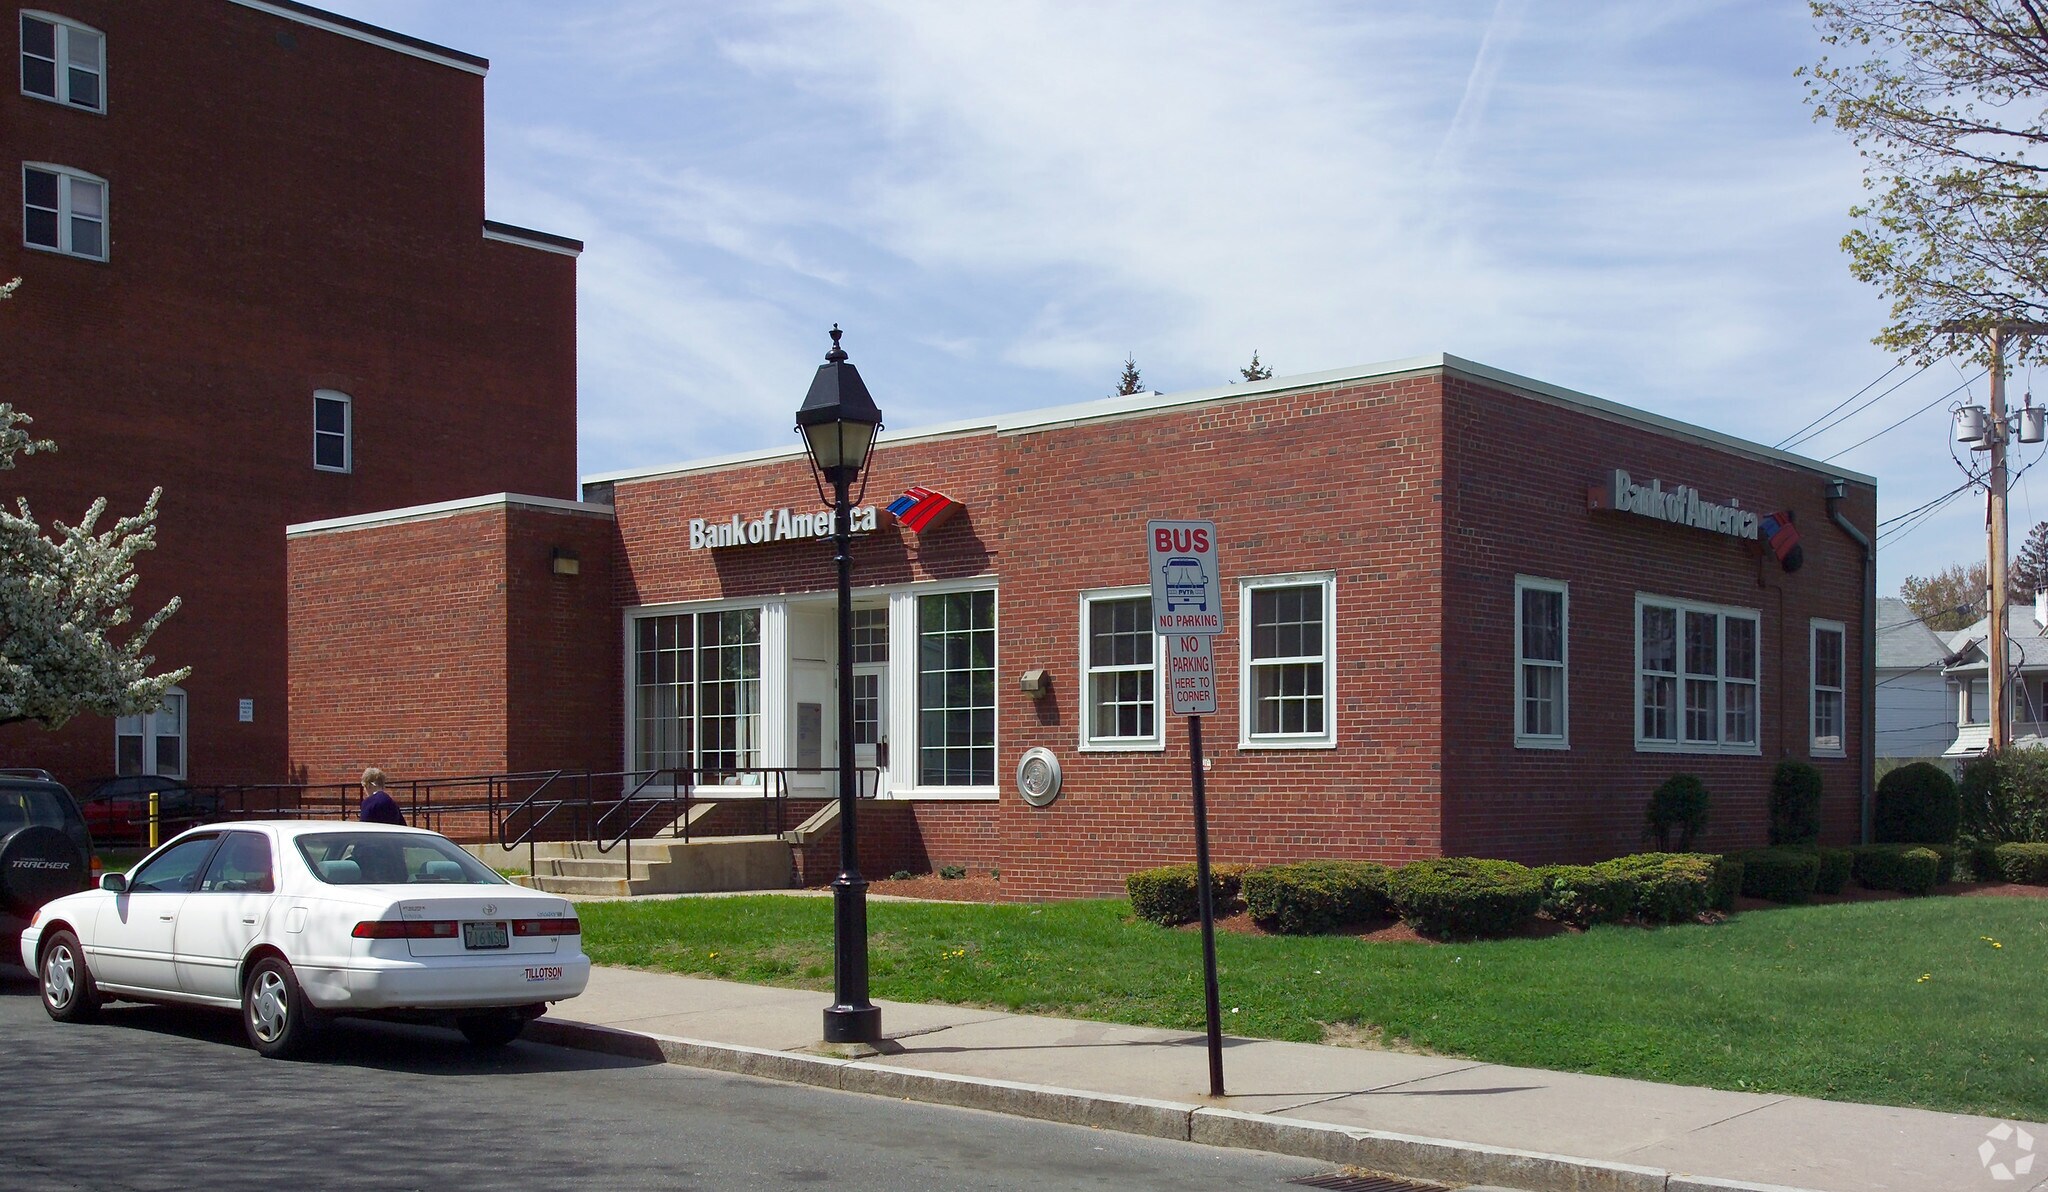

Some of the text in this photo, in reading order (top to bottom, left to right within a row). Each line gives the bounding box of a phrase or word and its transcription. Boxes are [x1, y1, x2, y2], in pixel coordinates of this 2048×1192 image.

[1614, 468, 1759, 540] Bank of America
[689, 505, 878, 550] Bank of Amerca
[1155, 528, 1210, 553] BUS
[1160, 614, 1218, 627] NO PARKING
[1181, 636, 1199, 652] NO
[1173, 657, 1210, 672] PARKING
[1175, 677, 1210, 689] HERE TO
[1177, 690, 1210, 702] CORNER
[12, 860, 70, 870] TRACKER
[525, 966, 563, 979] TILLOTSON
